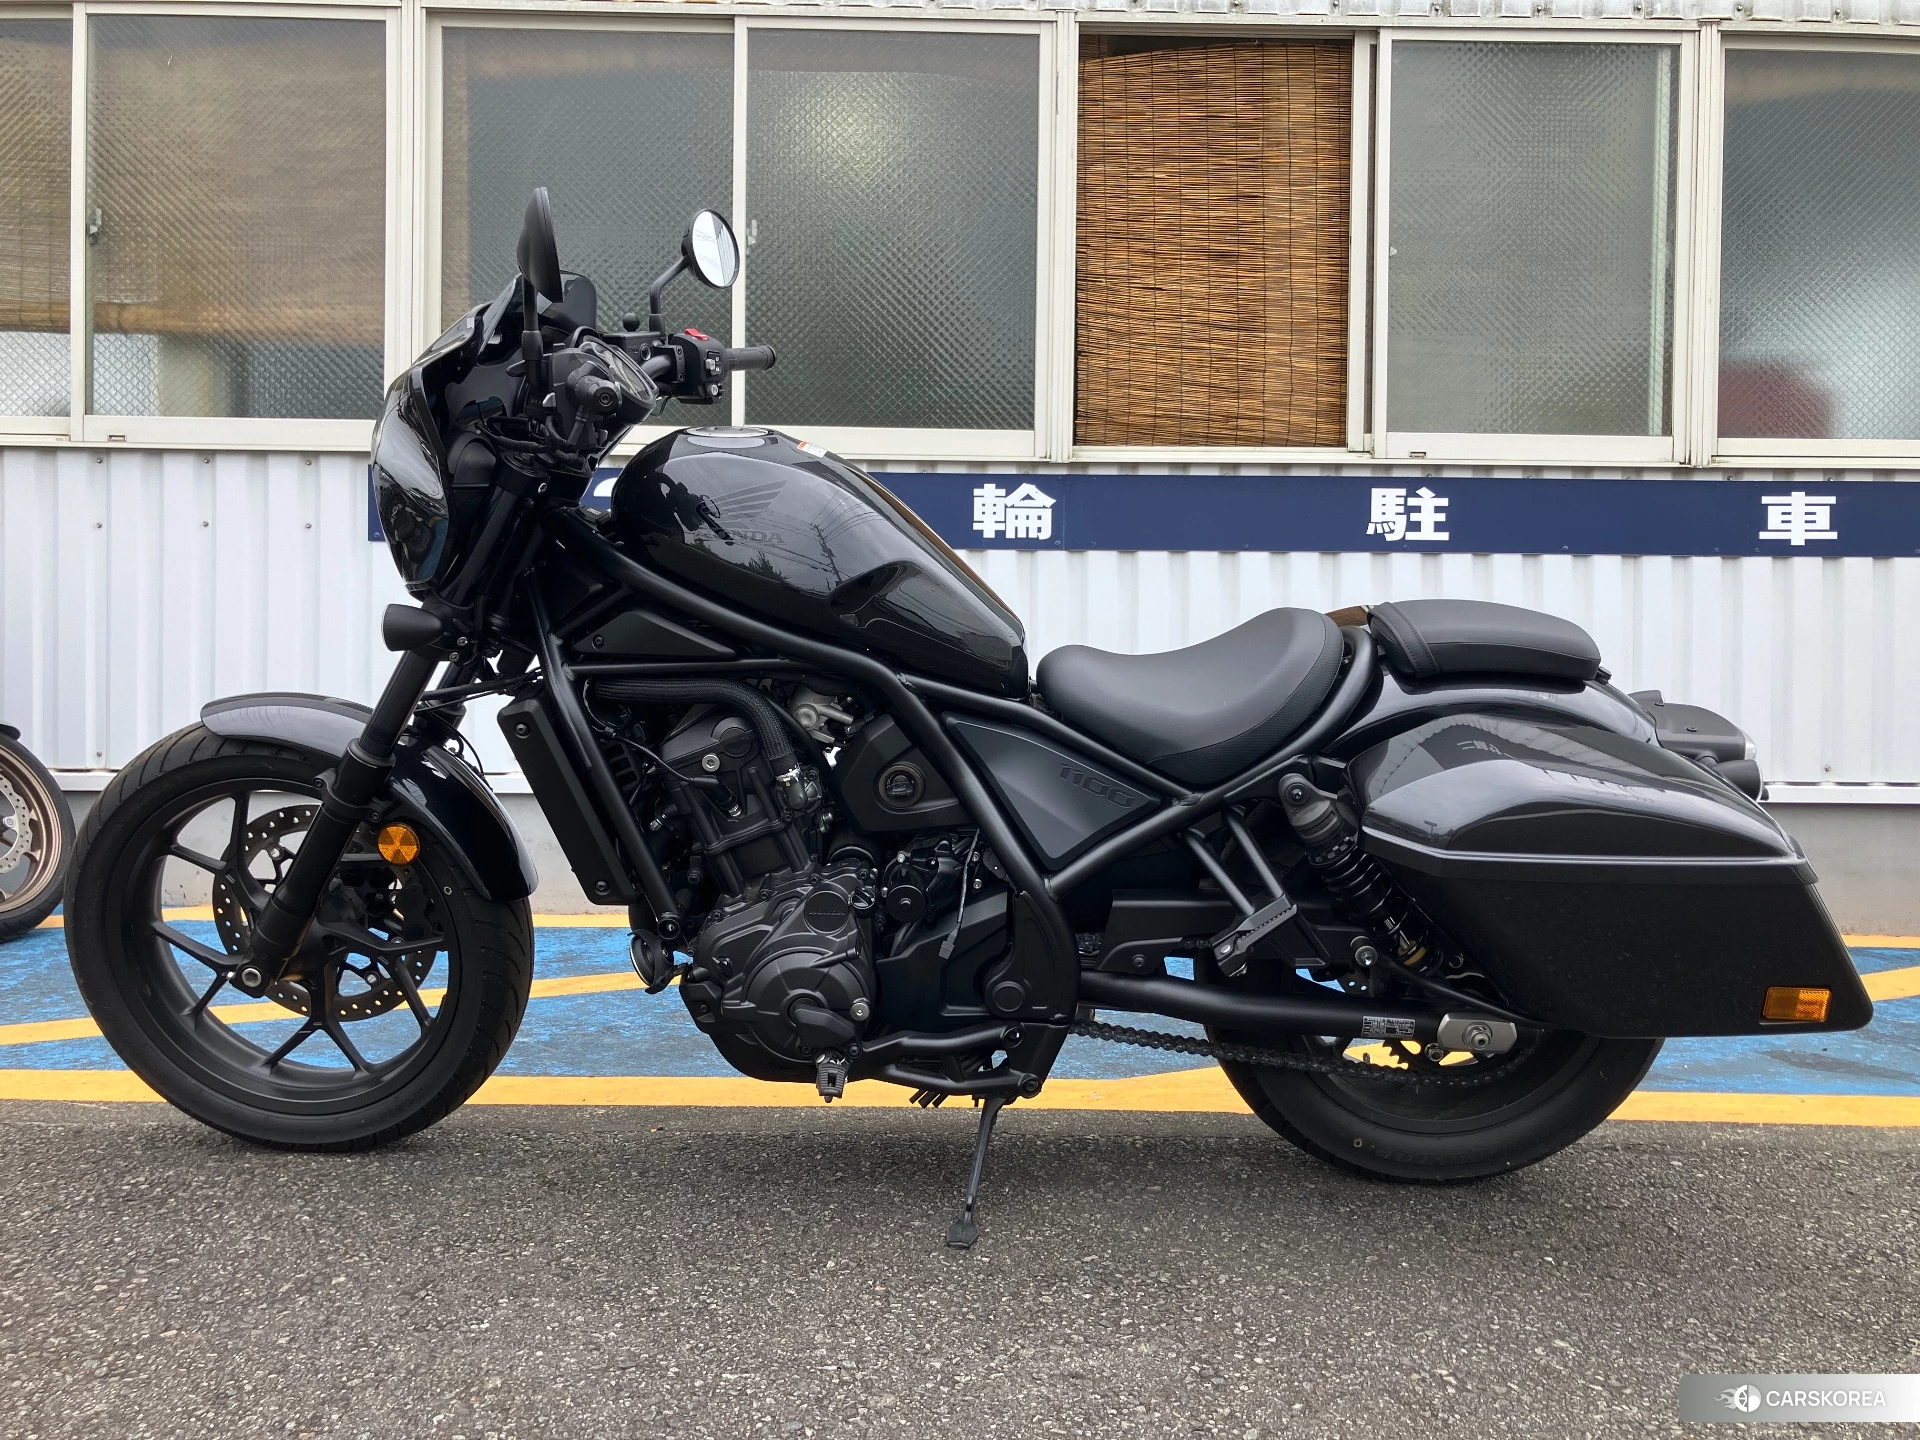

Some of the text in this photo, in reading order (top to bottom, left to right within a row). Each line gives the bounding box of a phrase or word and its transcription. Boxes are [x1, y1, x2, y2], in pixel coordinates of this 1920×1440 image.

[972, 482, 1839, 546] 輪 駐 車
